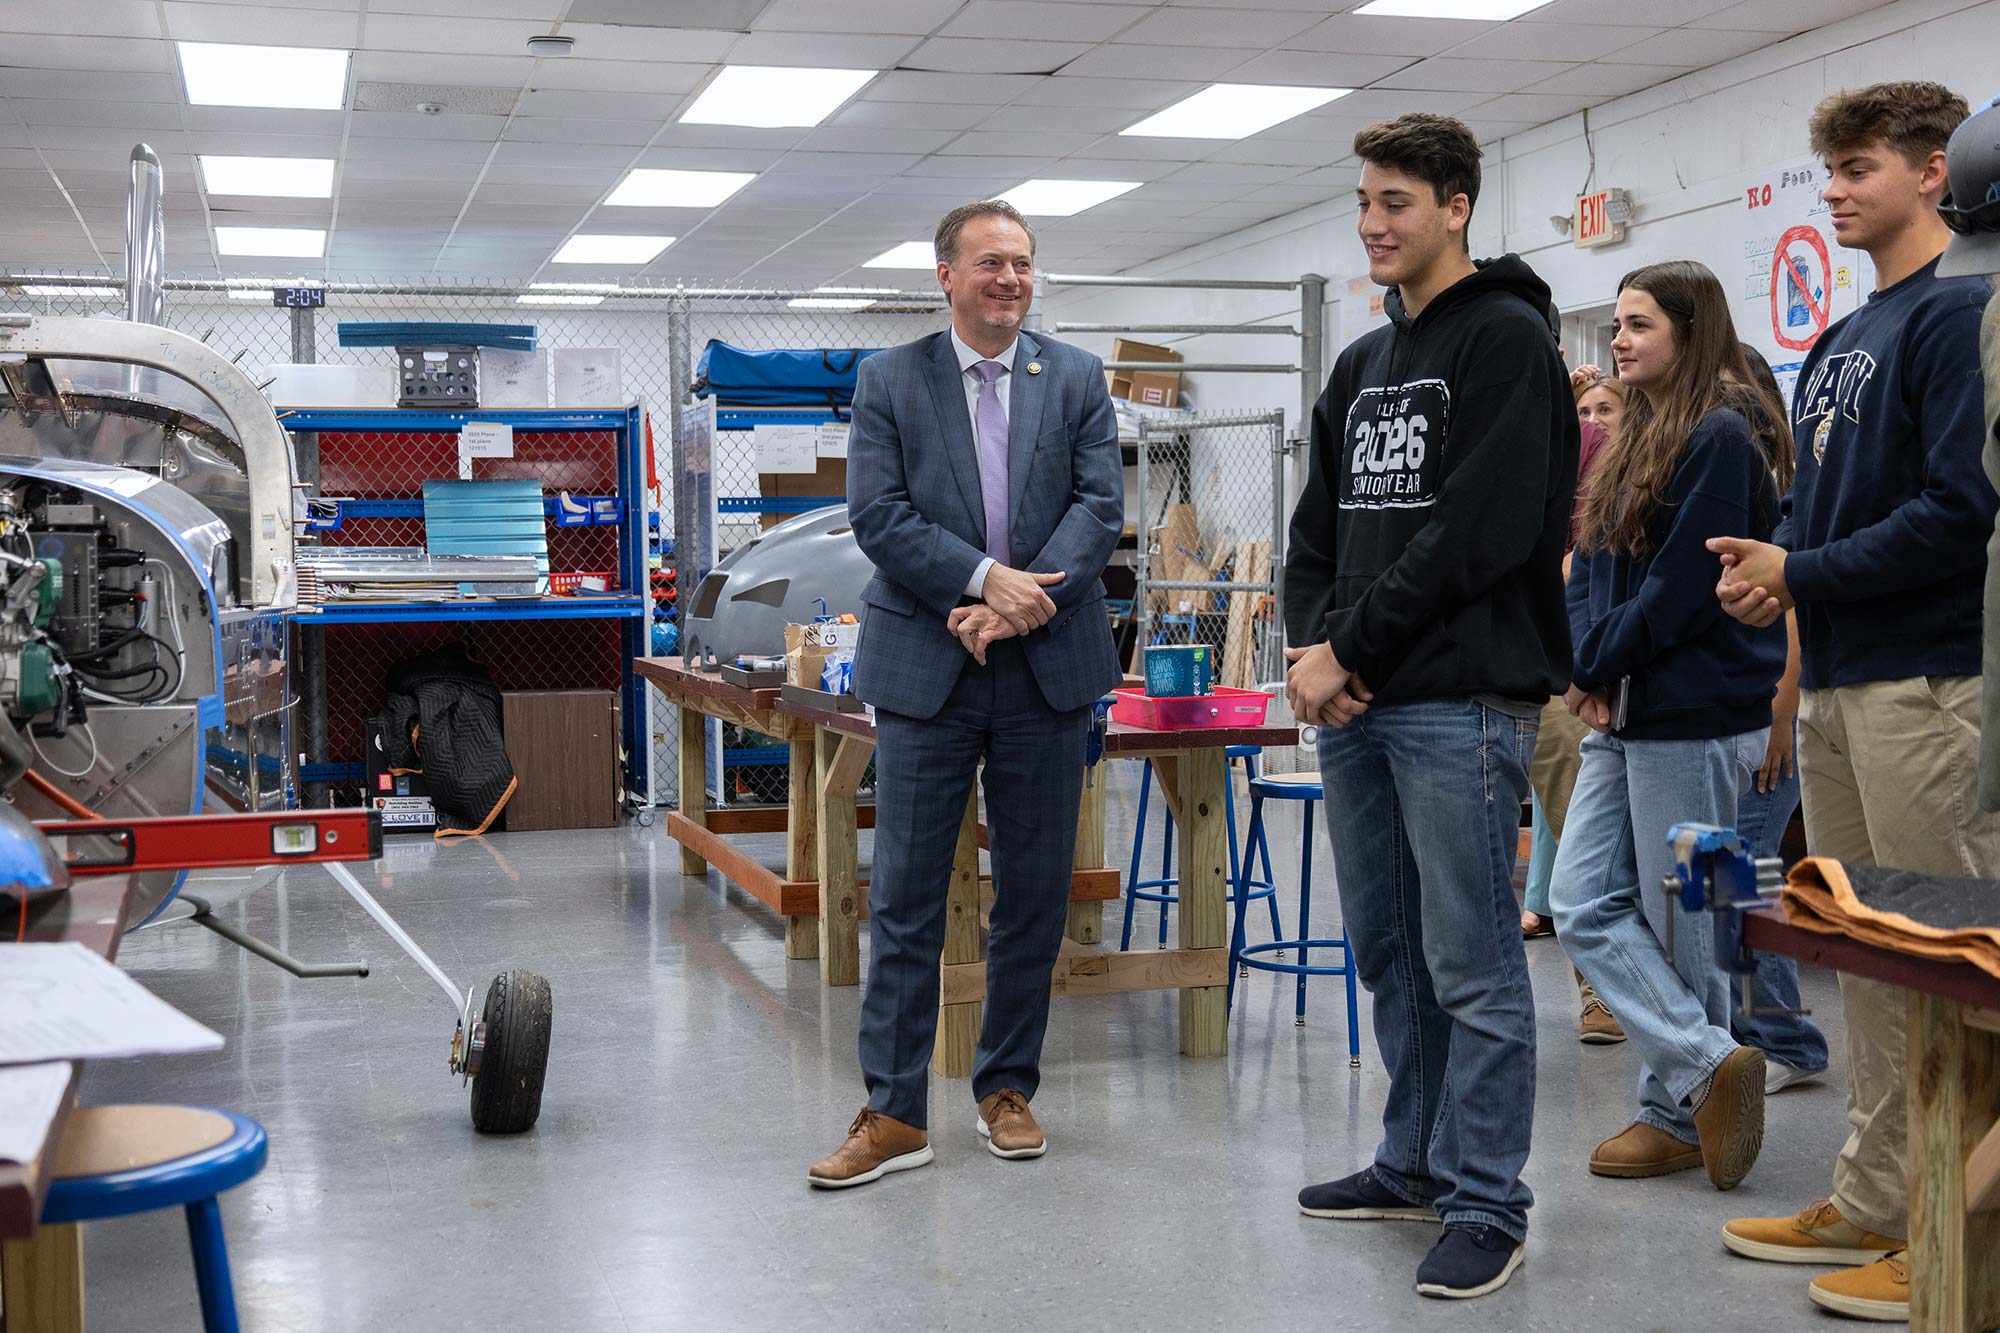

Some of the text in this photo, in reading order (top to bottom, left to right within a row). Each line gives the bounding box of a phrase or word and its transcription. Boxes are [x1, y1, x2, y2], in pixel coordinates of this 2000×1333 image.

[1747, 184, 1772, 209] NO
[1581, 193, 1607, 238] EXIT
[1751, 256, 1769, 274] THE
[286, 288, 321, 306] 2:04
[1351, 414, 1428, 473] 2026
[1352, 473, 1420, 496] SNIOR YEAR
[1149, 658, 1174, 674] FLAVOR
[1153, 678, 1175, 693] SAVOR
